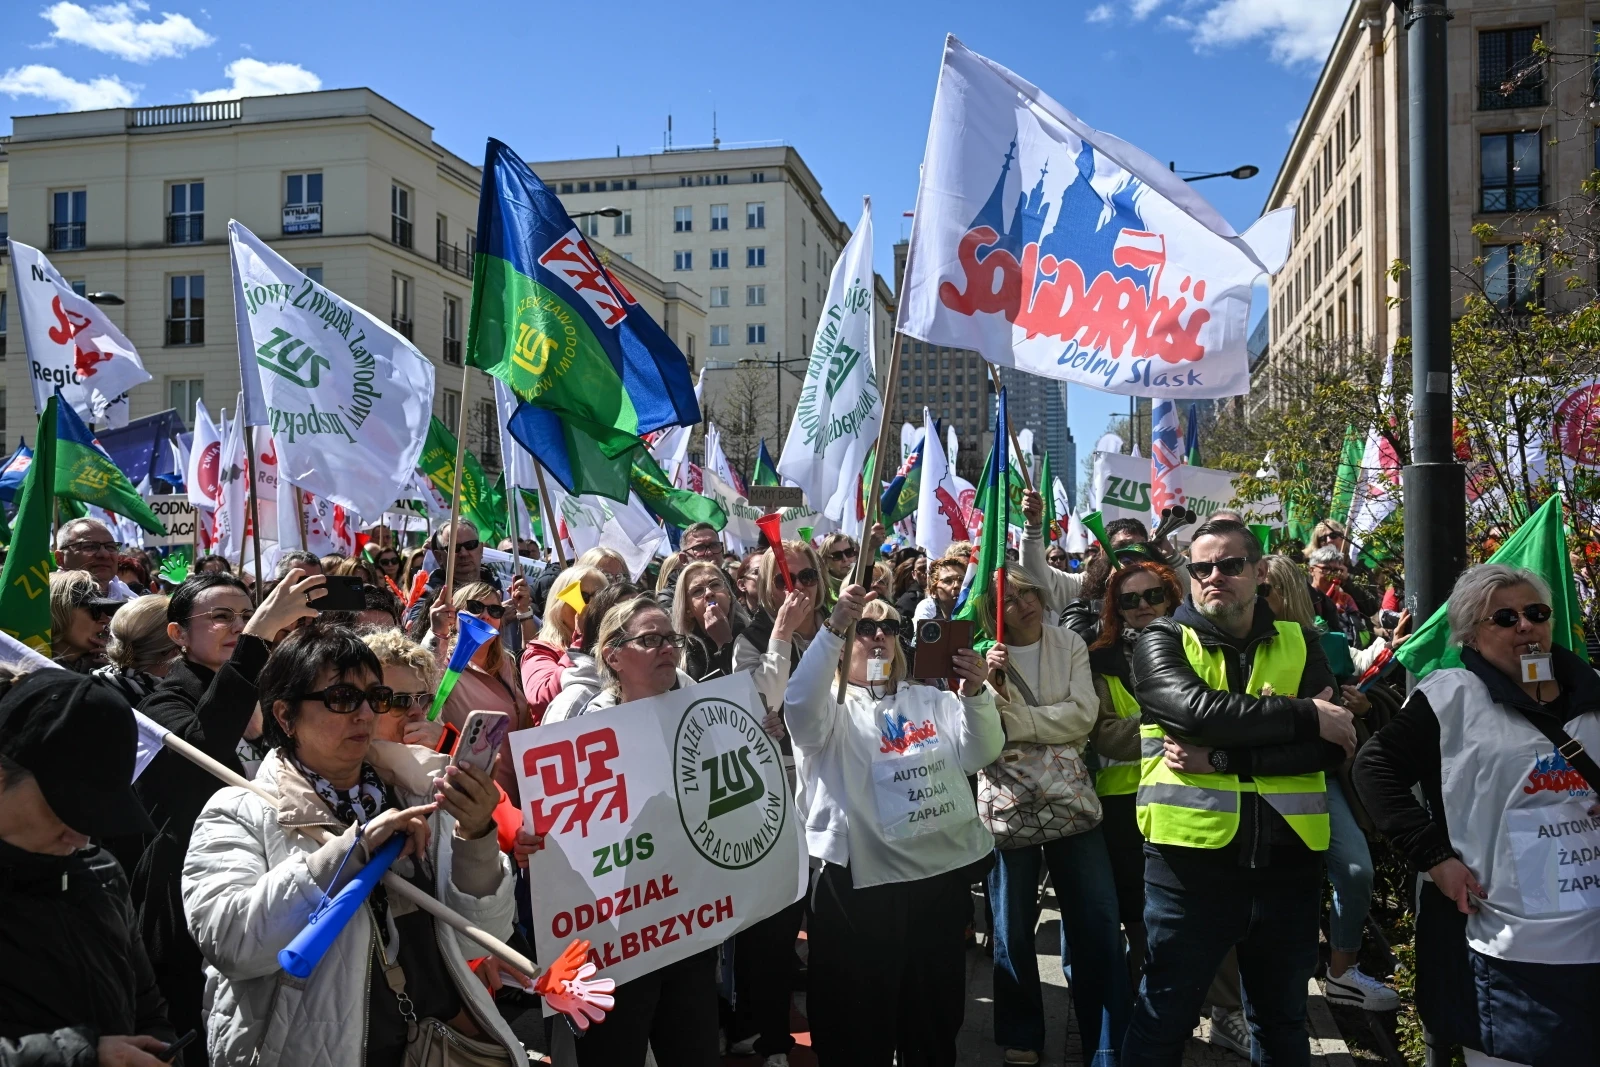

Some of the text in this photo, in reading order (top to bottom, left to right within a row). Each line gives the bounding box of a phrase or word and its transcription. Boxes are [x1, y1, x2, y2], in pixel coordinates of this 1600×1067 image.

[256, 326, 331, 389] ZUS
[512, 322, 559, 376] ZUS
[1057, 339, 1120, 387] Dolny
[751, 489, 775, 500] MAMY
[1101, 476, 1152, 512] ZUS
[681, 706, 772, 795] ZWIĄZEK ZAWODOWY
[893, 758, 946, 783] AUTOMATY
[701, 745, 765, 820] ZUS
[694, 792, 782, 863] PRACOWNIKÓW
[908, 801, 956, 823] ZAPŁATY
[592, 832, 655, 878] ZUS
[551, 873, 679, 939] ODDZIAŁ
[586, 895, 734, 972] AŁBRZYCH
